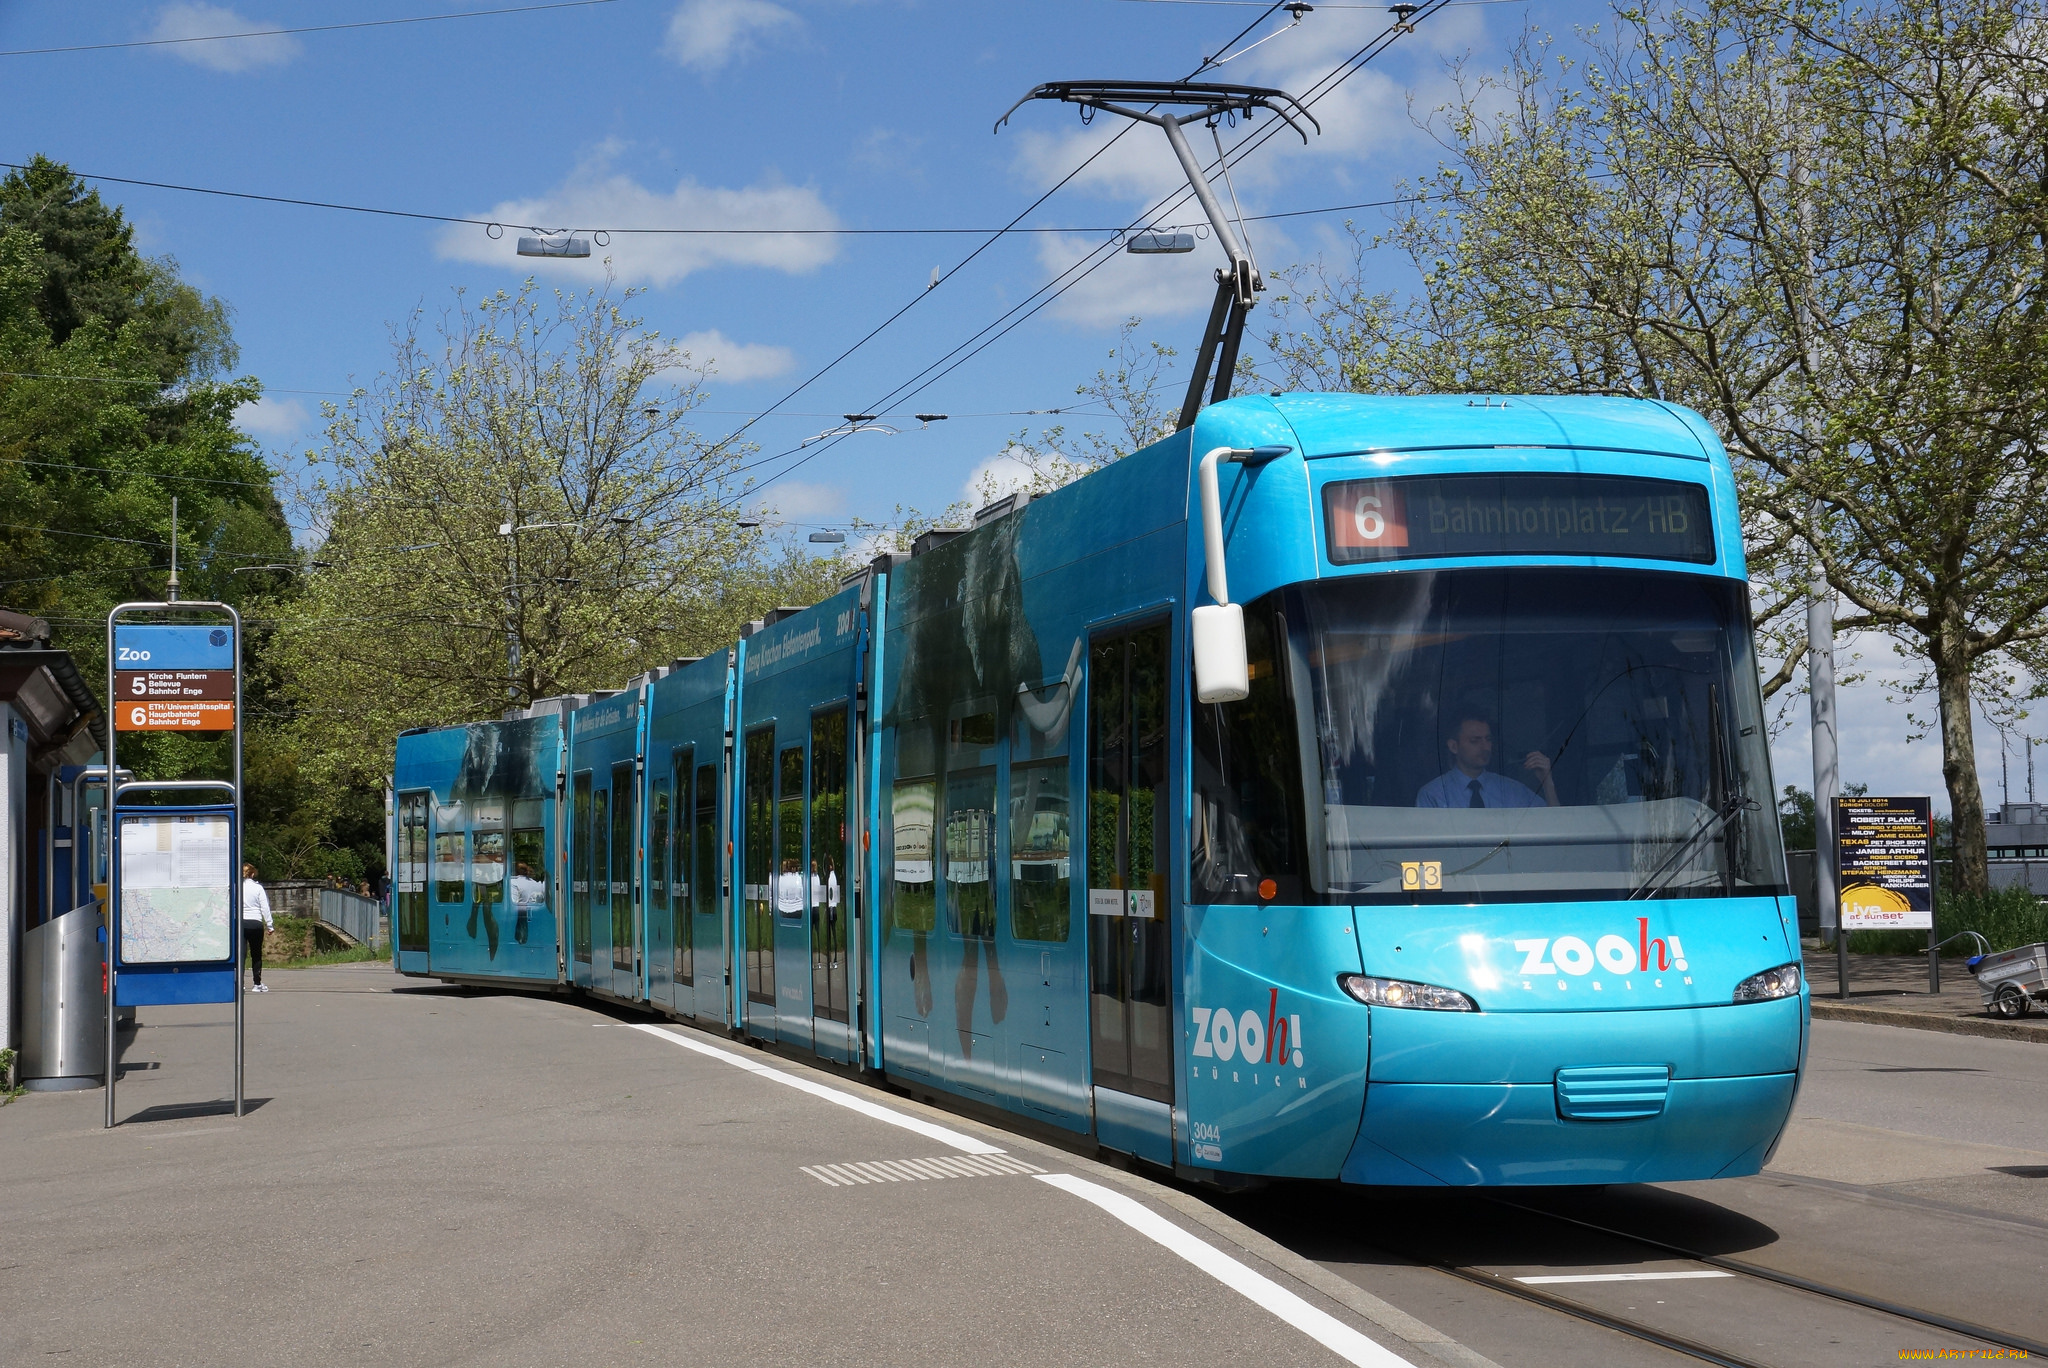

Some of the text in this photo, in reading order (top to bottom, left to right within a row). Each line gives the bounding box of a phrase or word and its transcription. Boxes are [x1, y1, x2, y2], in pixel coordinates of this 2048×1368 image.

[1354, 495, 1689, 540] 6 Bahnhofplatz/HB
[118, 647, 151, 661] Zoo
[131, 677, 147, 695] 5
[183, 688, 203, 696] Enge
[148, 703, 231, 711] ETH/Universitätsspital
[131, 707, 147, 726] 6
[148, 711, 200, 719] Hauptbahnhof
[182, 718, 201, 726] Enge
[1404, 865, 1439, 886] 03
[1843, 902, 1882, 914] Live
[1864, 912, 1904, 920] sunset
[1194, 1121, 1220, 1142] 3044
